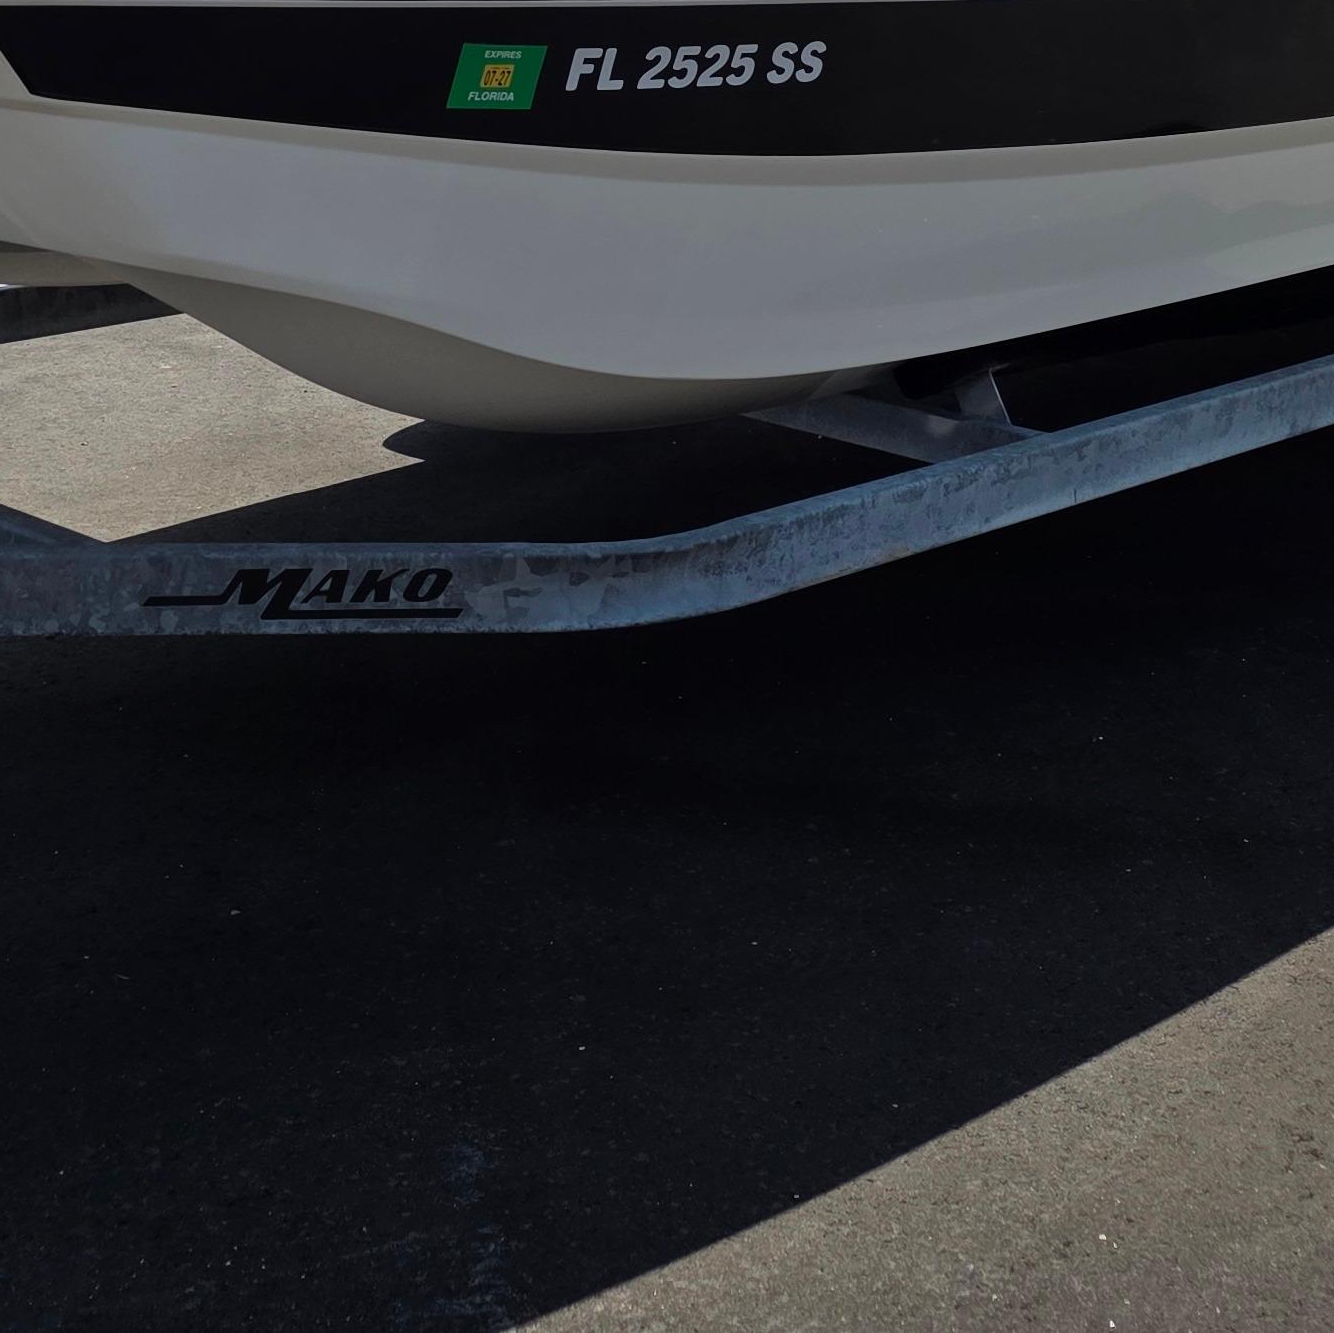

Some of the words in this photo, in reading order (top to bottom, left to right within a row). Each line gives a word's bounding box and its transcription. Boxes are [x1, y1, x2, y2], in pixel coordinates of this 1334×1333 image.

[484, 50, 523, 59] EXPIRES
[565, 47, 624, 91] FL
[636, 44, 759, 90] 2525
[766, 40, 828, 84] SS
[483, 70, 511, 87] 07-27
[467, 91, 515, 102] FLORIDA
[142, 568, 464, 620] MAKO
